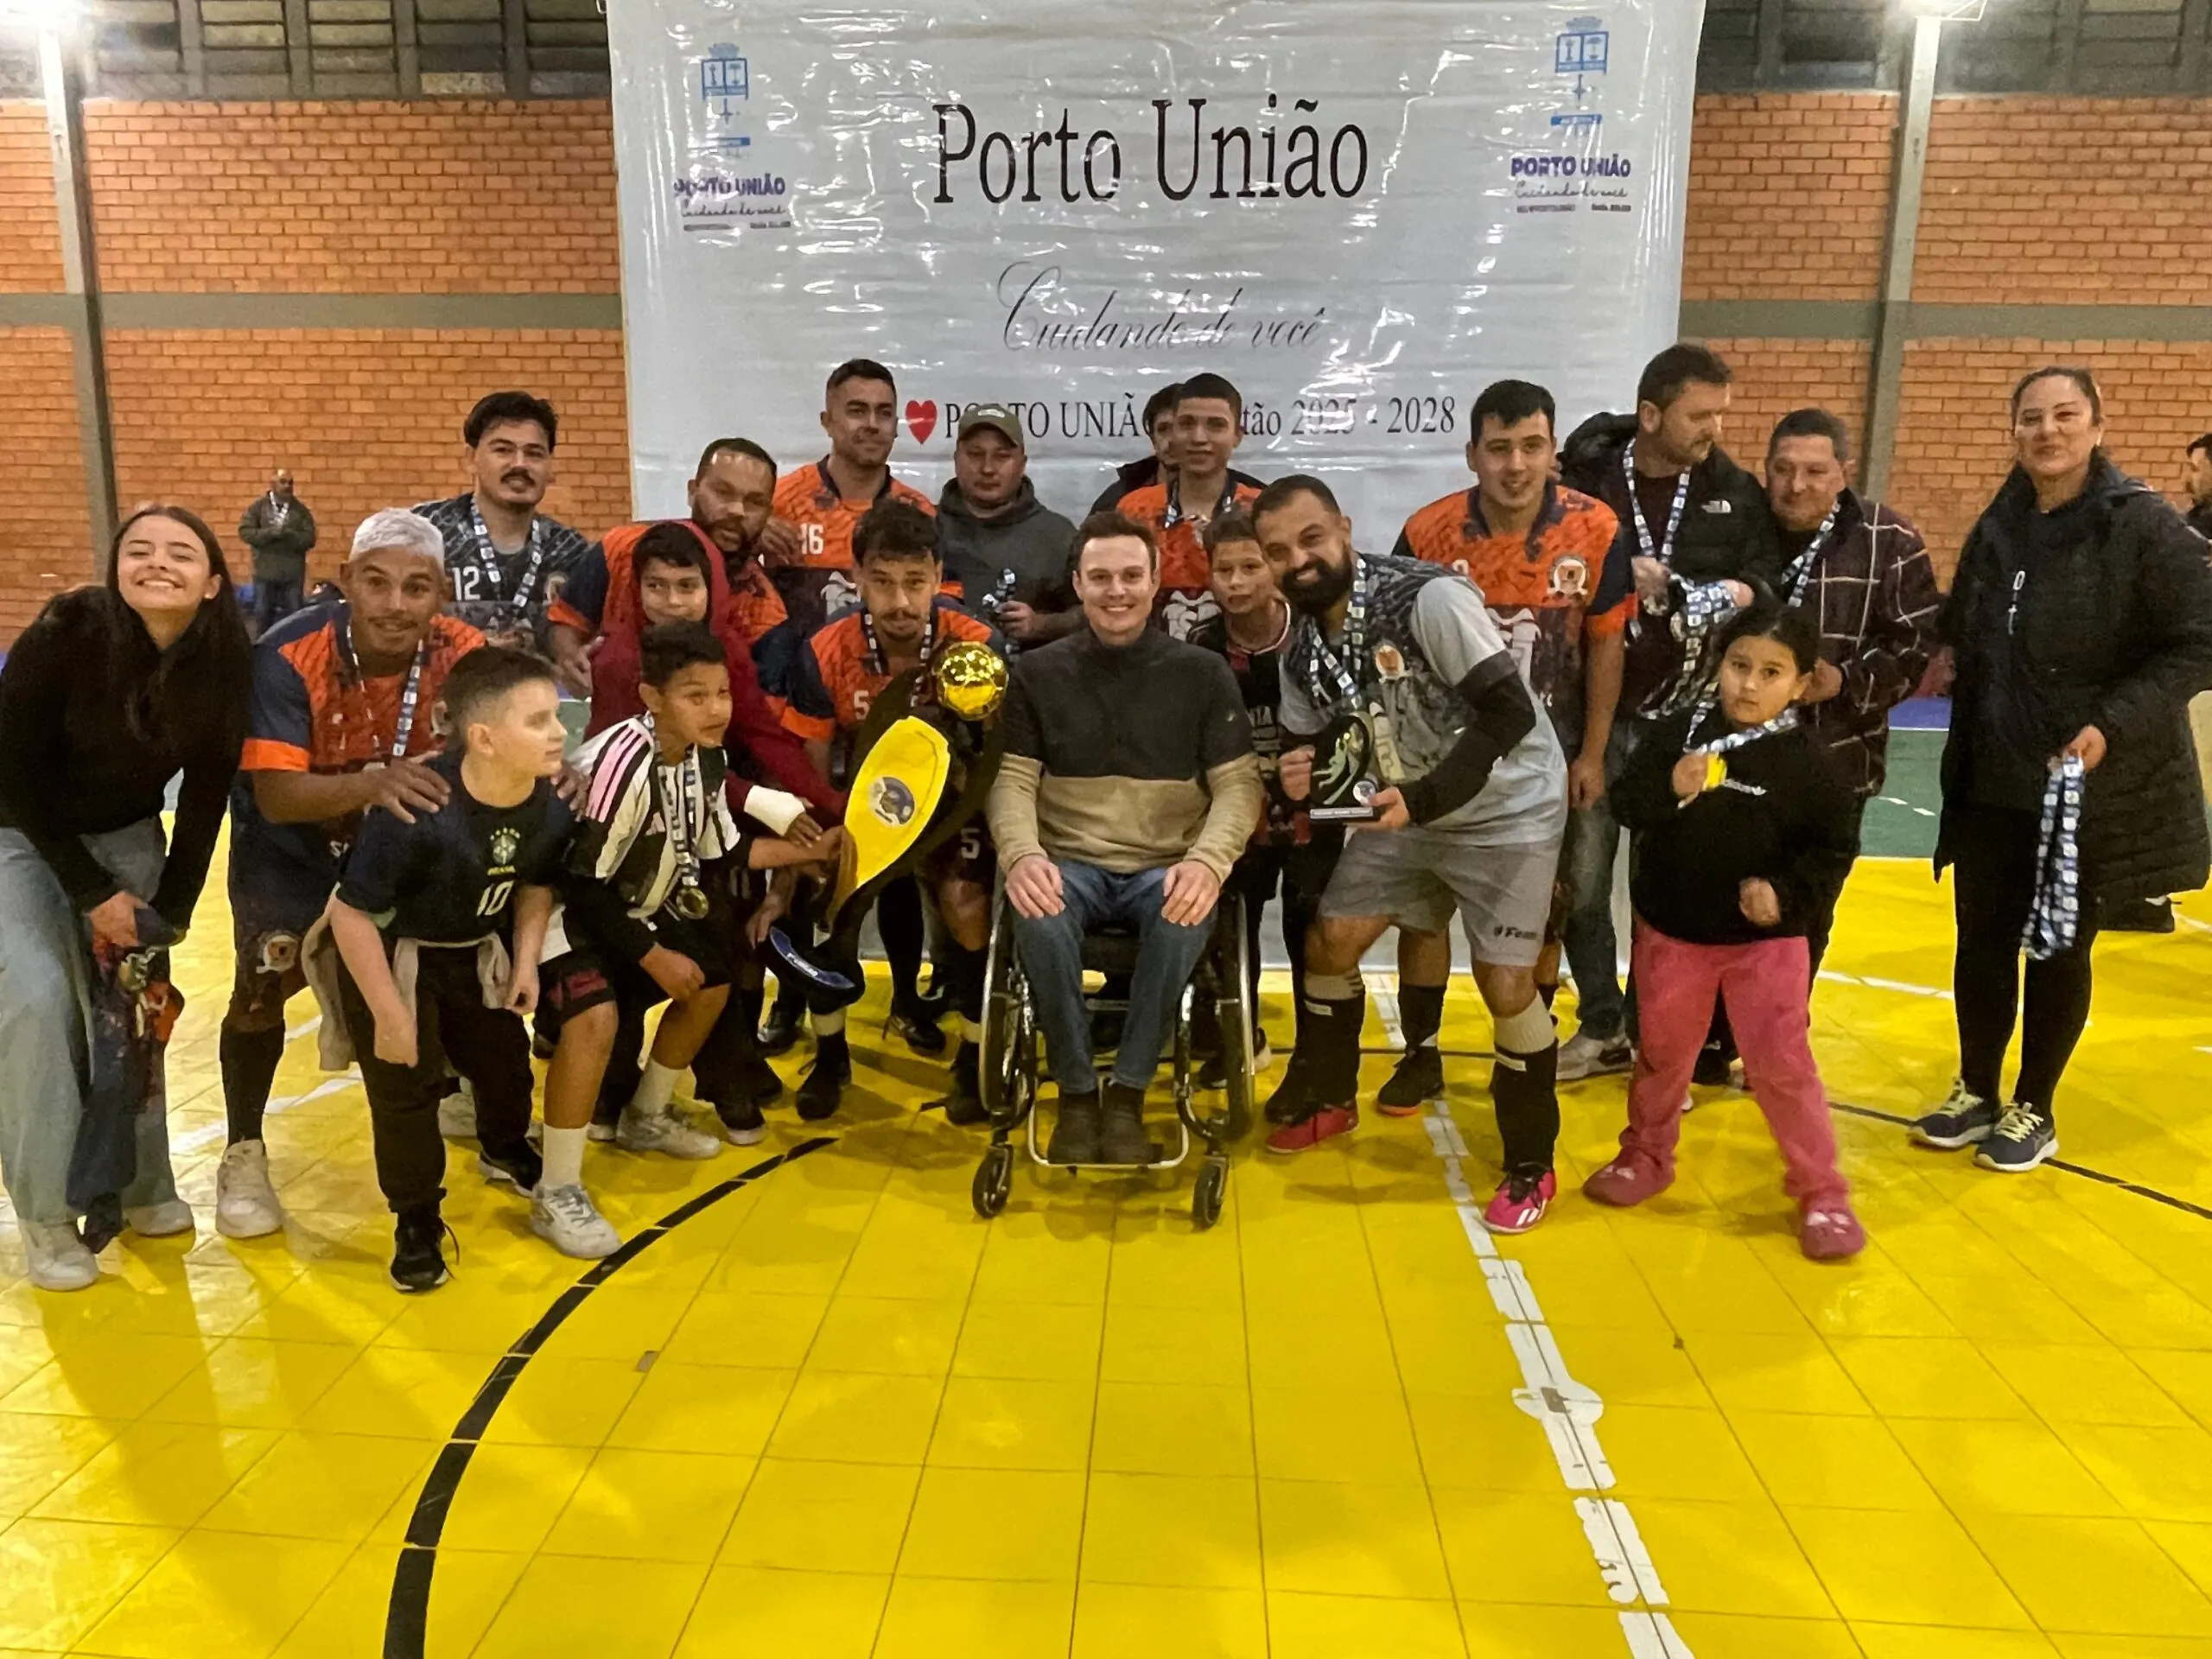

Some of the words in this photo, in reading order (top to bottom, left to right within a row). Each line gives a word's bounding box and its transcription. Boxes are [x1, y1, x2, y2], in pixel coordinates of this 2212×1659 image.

[931, 103, 1122, 205] Porto
[1151, 92, 1369, 201] União
[1511, 156, 1577, 178] PORTO
[1580, 153, 1631, 178] UNIÃO
[734, 172, 786, 196] UNIÃO
[944, 401, 1051, 438] PTO
[1059, 391, 1151, 438] UNIÃ
[1243, 401, 1282, 436] tão
[1387, 396, 1456, 434] 2028
[800, 522, 824, 555] 16
[452, 565, 480, 601] 12
[854, 690, 871, 721] 5
[960, 827, 981, 860] 5
[476, 880, 516, 916] 10
